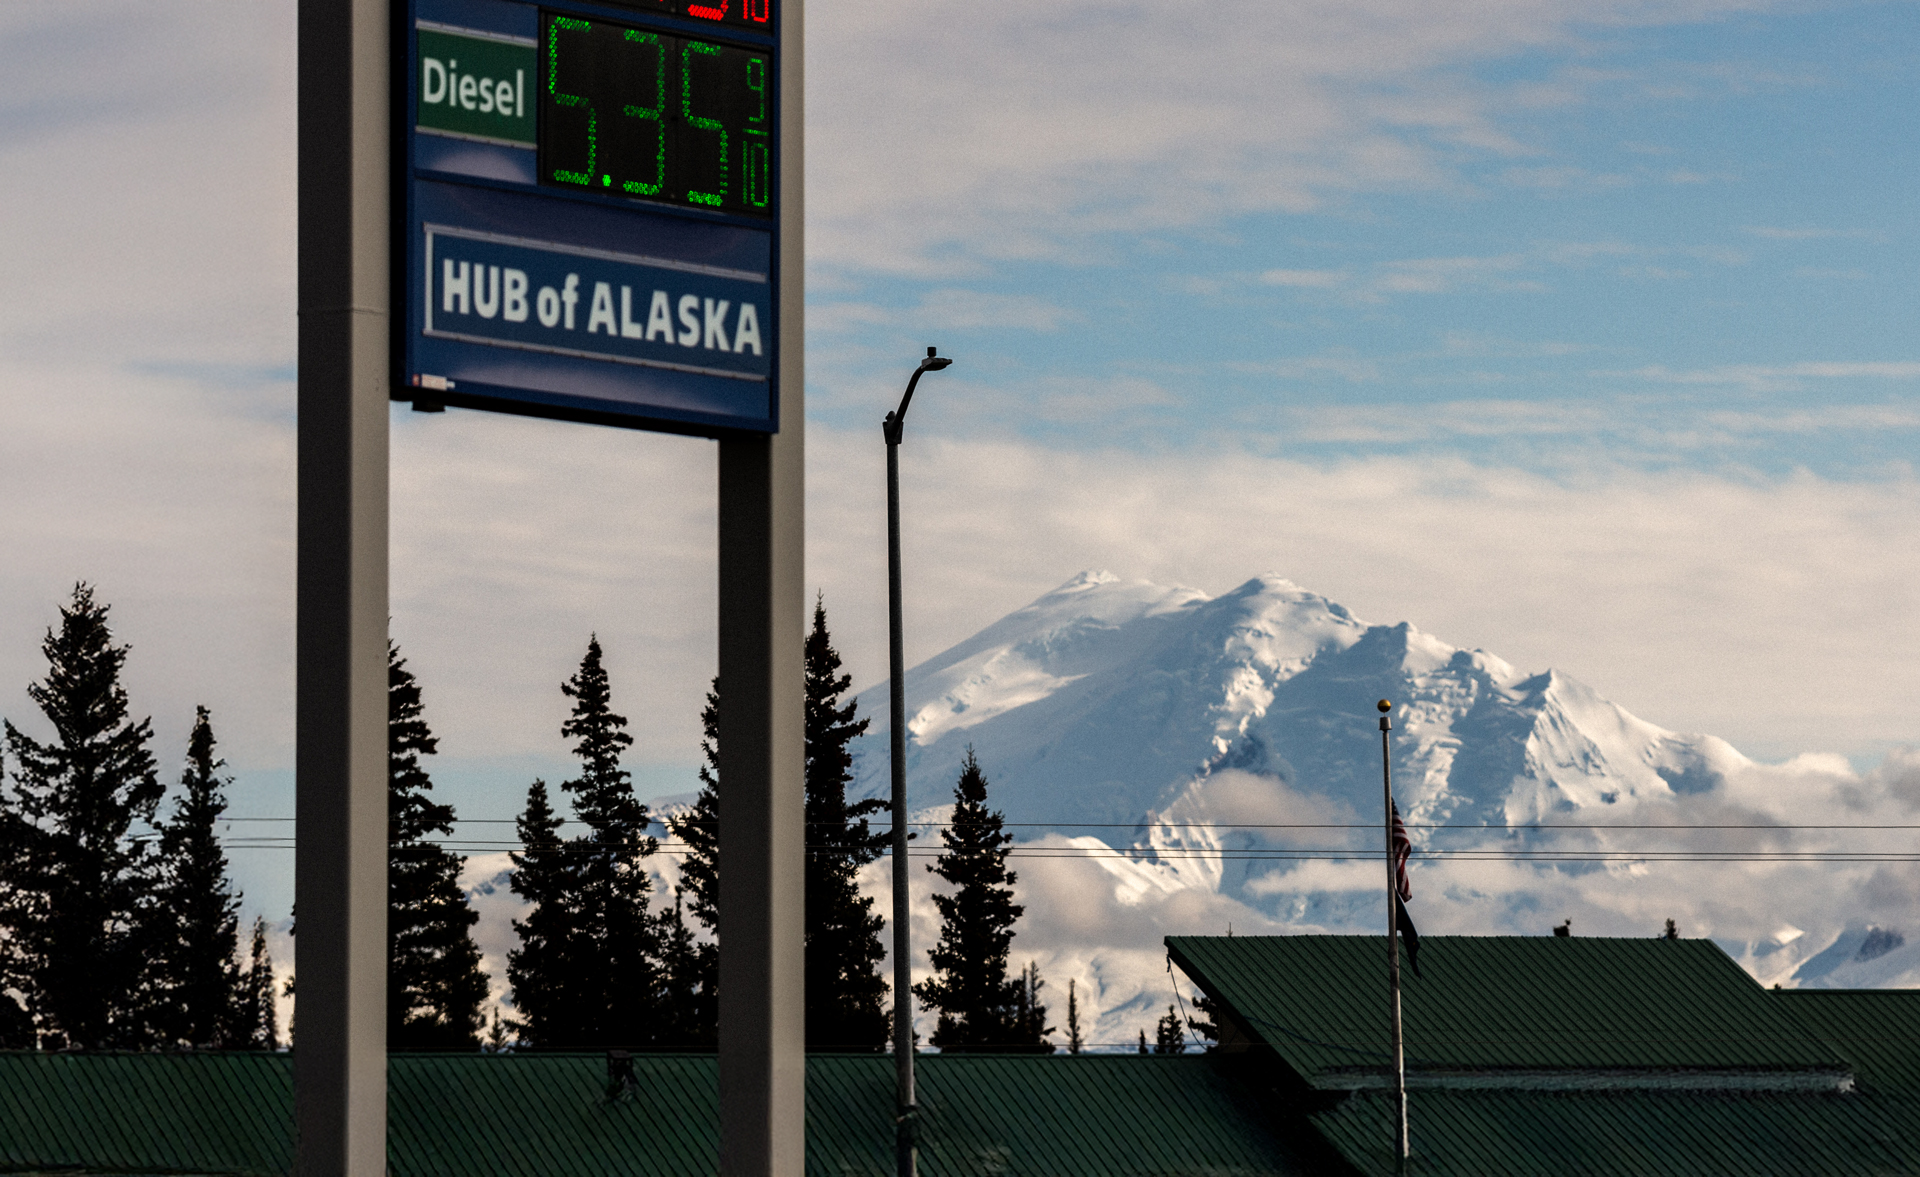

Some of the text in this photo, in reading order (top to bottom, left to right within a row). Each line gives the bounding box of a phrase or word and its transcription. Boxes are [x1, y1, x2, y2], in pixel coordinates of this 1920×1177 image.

[422, 57, 524, 118] Diesel
[548, 16, 729, 207] 5.35
[746, 57, 765, 123] 9
[742, 140, 769, 208] 10
[443, 258, 763, 356] HUB of ALASKA
